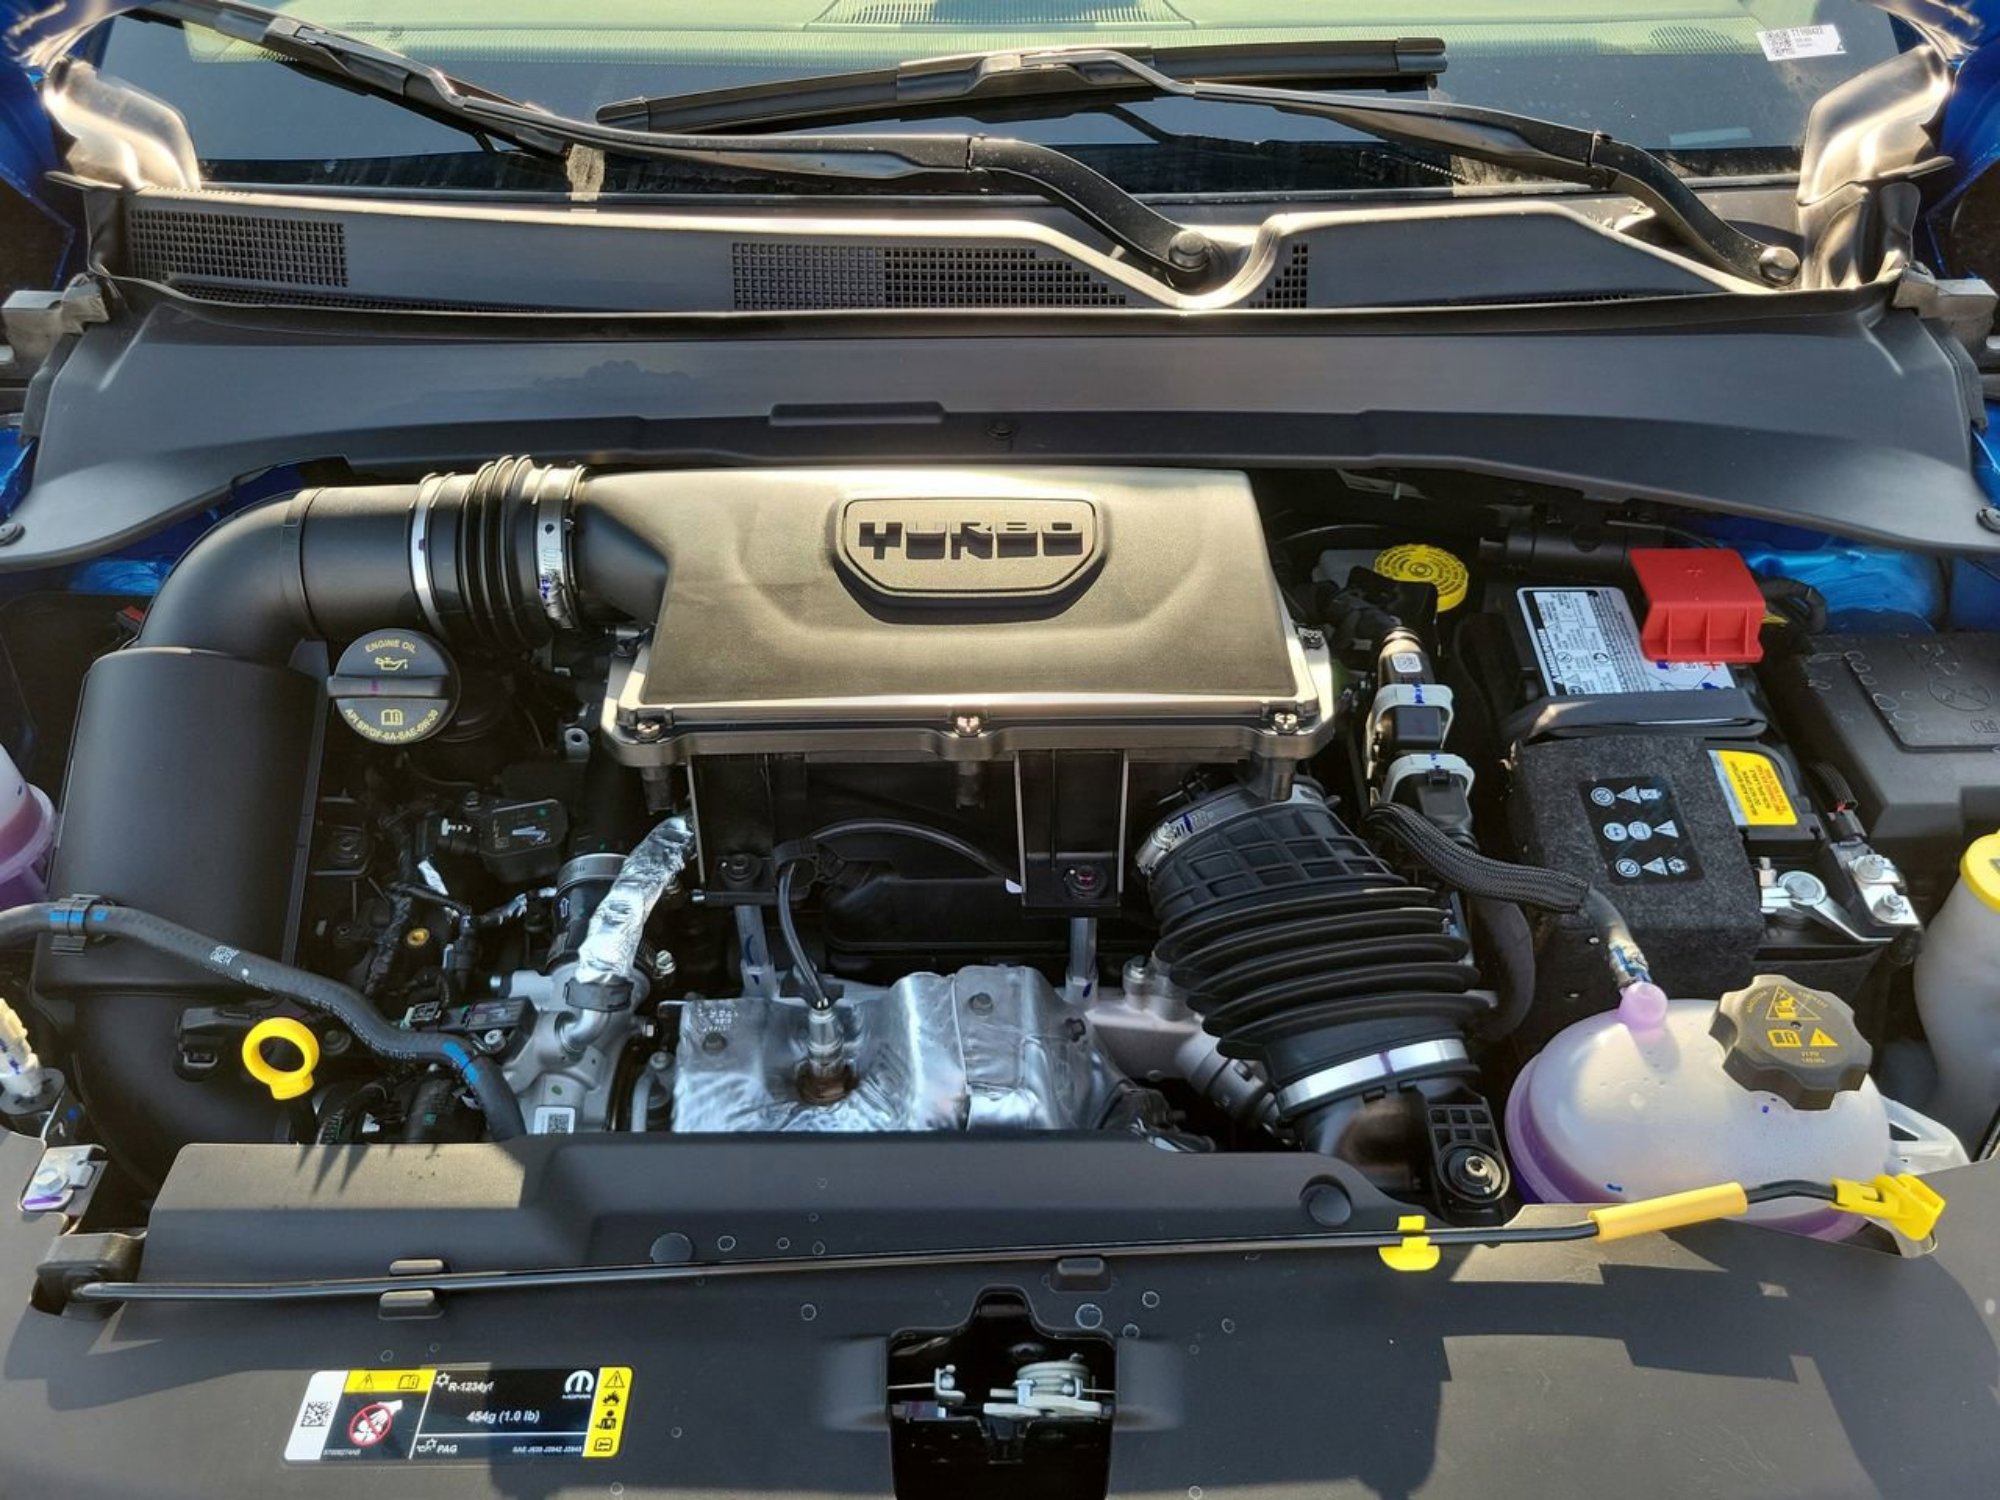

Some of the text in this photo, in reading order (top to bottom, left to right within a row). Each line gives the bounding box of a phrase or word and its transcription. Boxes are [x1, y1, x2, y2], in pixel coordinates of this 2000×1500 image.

[365, 639, 416, 654] ENGINE OIL
[466, 1410, 540, 1424] 454g (1.0 lb)
[437, 1444, 458, 1454] PAG
